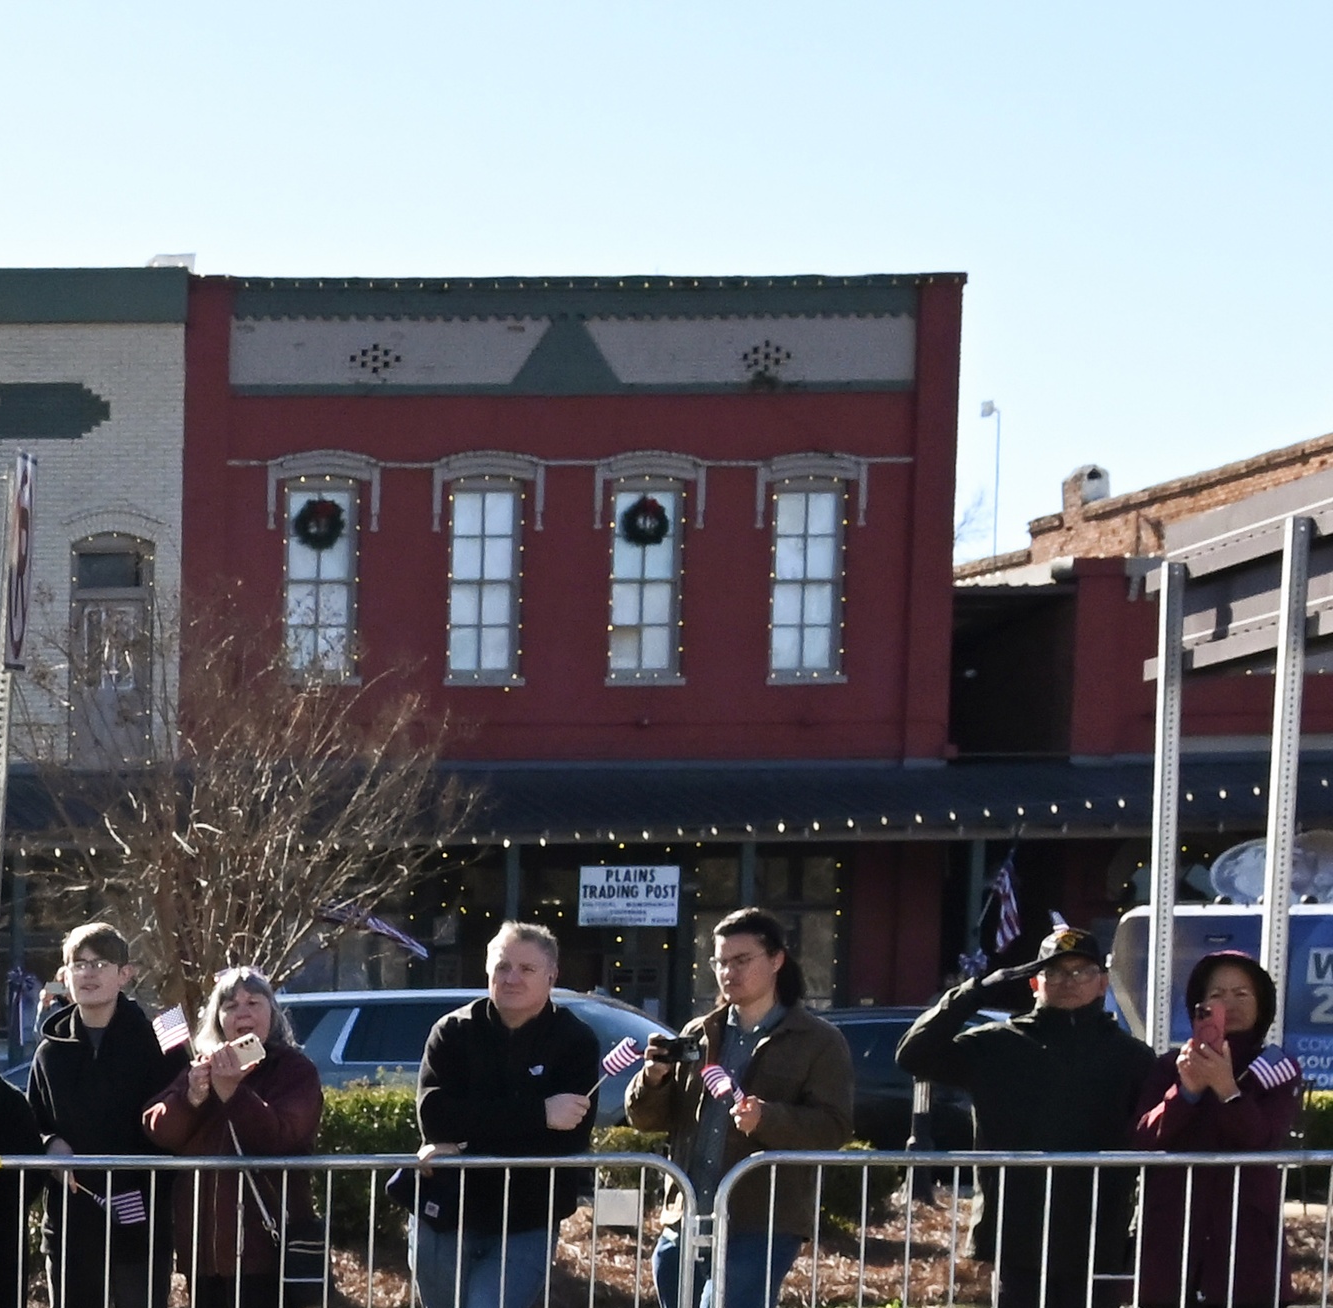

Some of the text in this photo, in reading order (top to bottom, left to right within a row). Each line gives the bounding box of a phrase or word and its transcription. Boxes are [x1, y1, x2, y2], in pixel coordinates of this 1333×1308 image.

[605, 869, 656, 883] PLAINS
[582, 885, 677, 899] TRADING POST
